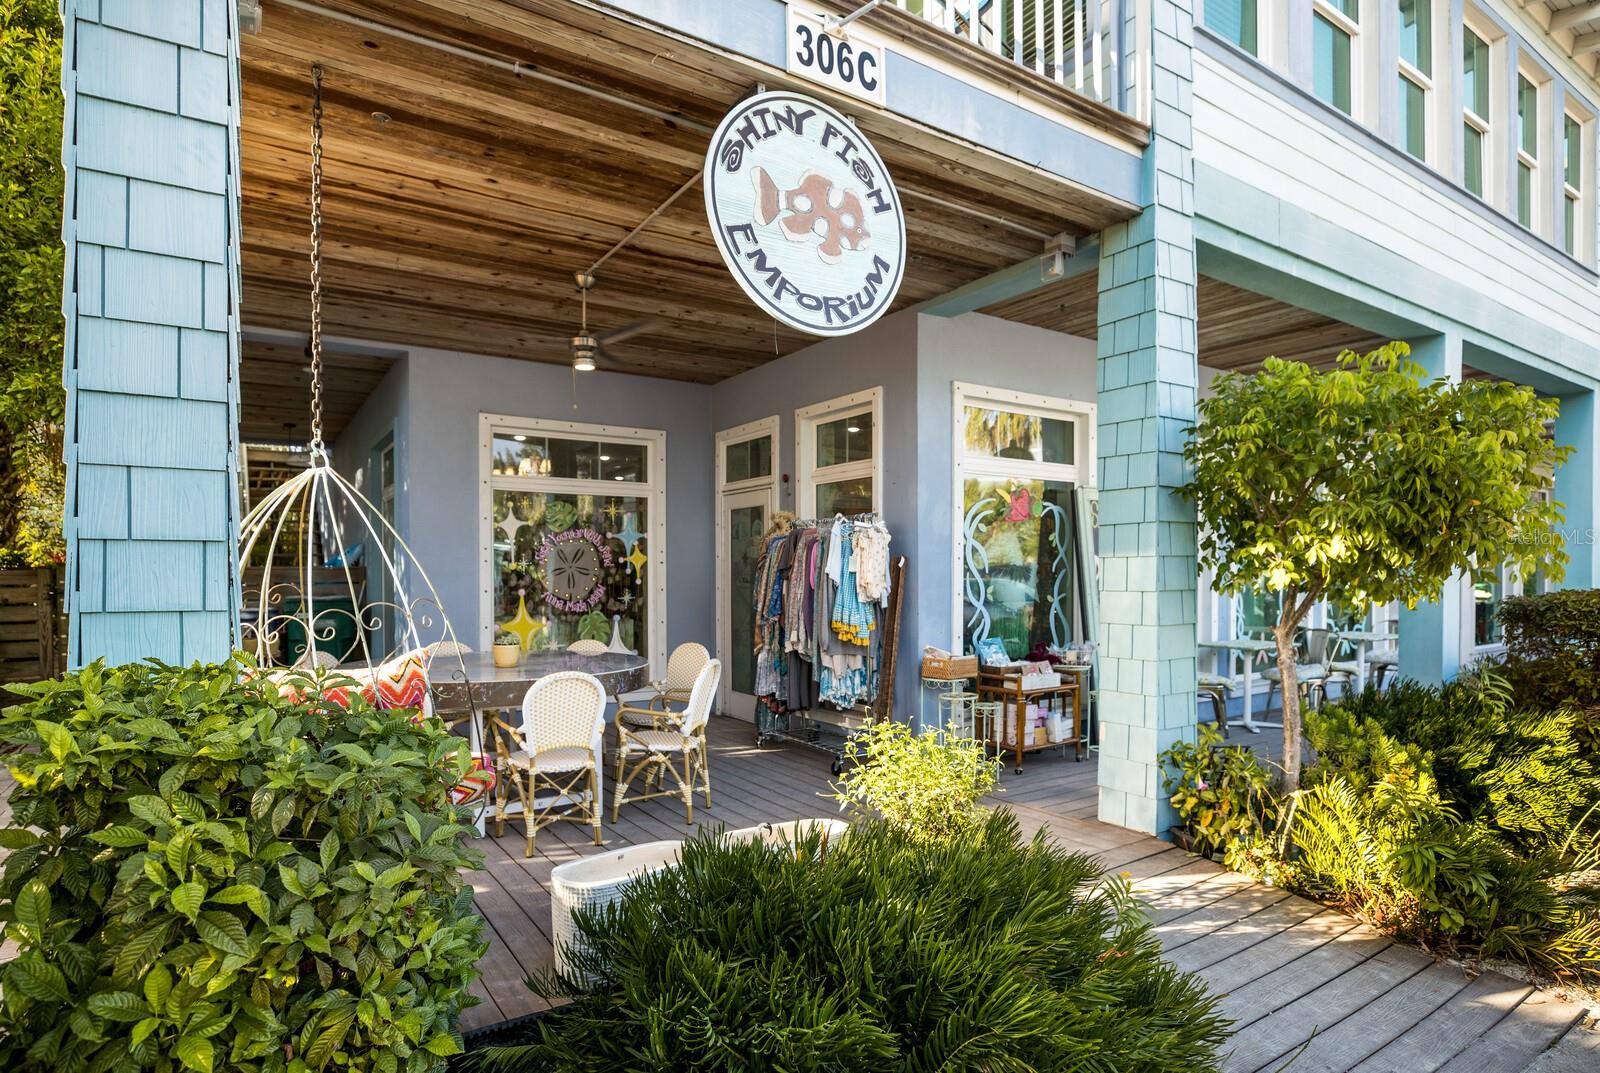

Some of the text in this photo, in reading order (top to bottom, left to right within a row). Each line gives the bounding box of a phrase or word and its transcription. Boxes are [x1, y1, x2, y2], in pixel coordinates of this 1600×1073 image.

[796, 24, 877, 92] 306C
[721, 104, 892, 214] SHINY FISH
